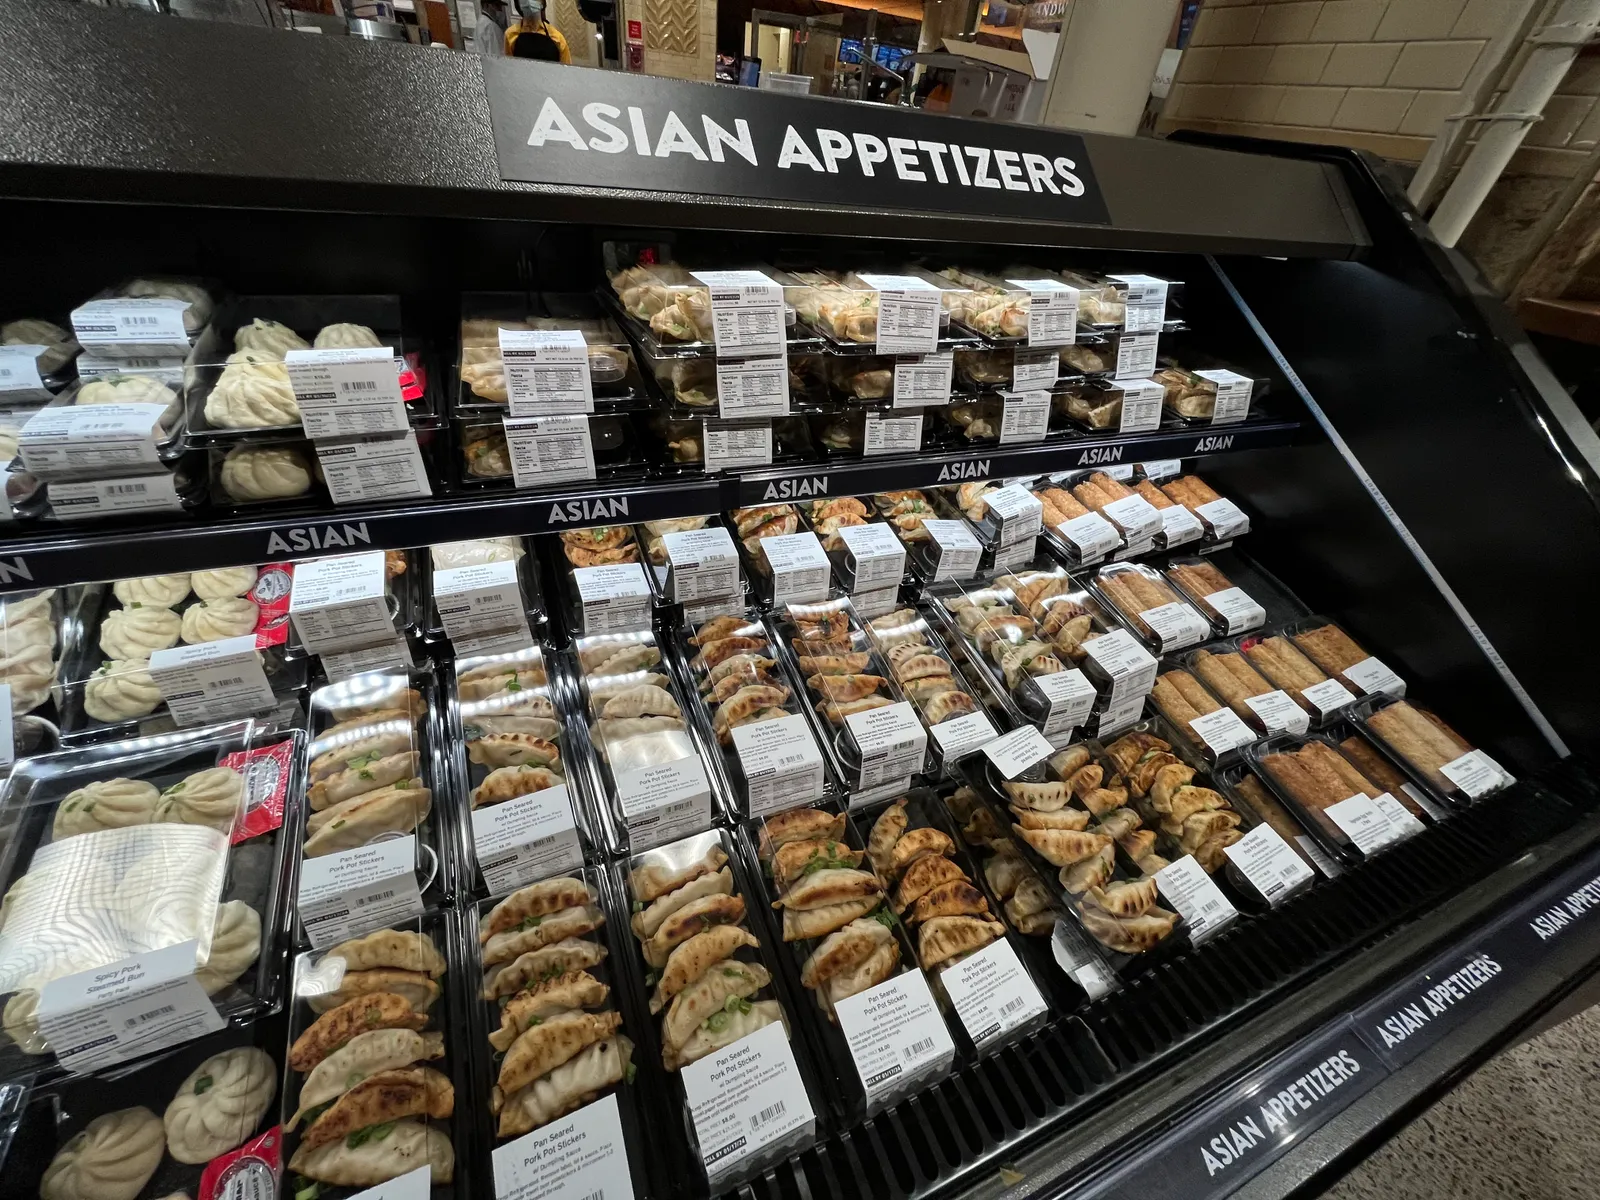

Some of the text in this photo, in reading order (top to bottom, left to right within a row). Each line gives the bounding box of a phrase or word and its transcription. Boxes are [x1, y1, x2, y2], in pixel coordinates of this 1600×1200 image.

[528, 97, 1085, 197] ASIAN APPETIZERS
[1195, 435, 1234, 452] ASIAN
[1078, 446, 1123, 465] ASIAN
[937, 460, 990, 481] ASIAN
[763, 477, 828, 500] ASIAN
[1364, 478, 1379, 496] LOAD
[548, 497, 629, 523] ASIAN
[267, 522, 371, 555] ASIAN
[1470, 624, 1488, 645] LOAD
[661, 771, 680, 779] Stickers
[494, 814, 507, 822] Pork
[519, 803, 541, 813] Stickers
[513, 799, 532, 809] Seared
[354, 849, 375, 859] Seared
[359, 855, 384, 865] Stickers
[1529, 905, 1574, 940] ASIAN
[94, 962, 141, 983] Spicy Pork
[961, 960, 996, 983] Pork Pot Stickers
[962, 956, 987, 973] Pan Seared
[86, 971, 145, 994] Steamed Bun
[863, 991, 907, 1016] Pork Pot Stickers
[867, 986, 897, 1004] Pan Seared
[1376, 954, 1502, 1048] ASIAN APPETIZERS
[715, 1045, 750, 1067] Pan Seared
[877, 1043, 890, 1052] $8.00
[710, 1050, 761, 1081] Pork Pot Stickers
[725, 1071, 745, 1086] Dumpling
[745, 1064, 758, 1074] Sauce
[721, 1112, 735, 1124] $8.00
[1200, 1049, 1361, 1176] ASIAN APPETIZERS
[533, 1123, 574, 1149] Pan Seared
[524, 1130, 586, 1166] Pork Pot Stickers
[539, 1153, 564, 1171] Dumpling
[565, 1146, 580, 1157] Sauce
